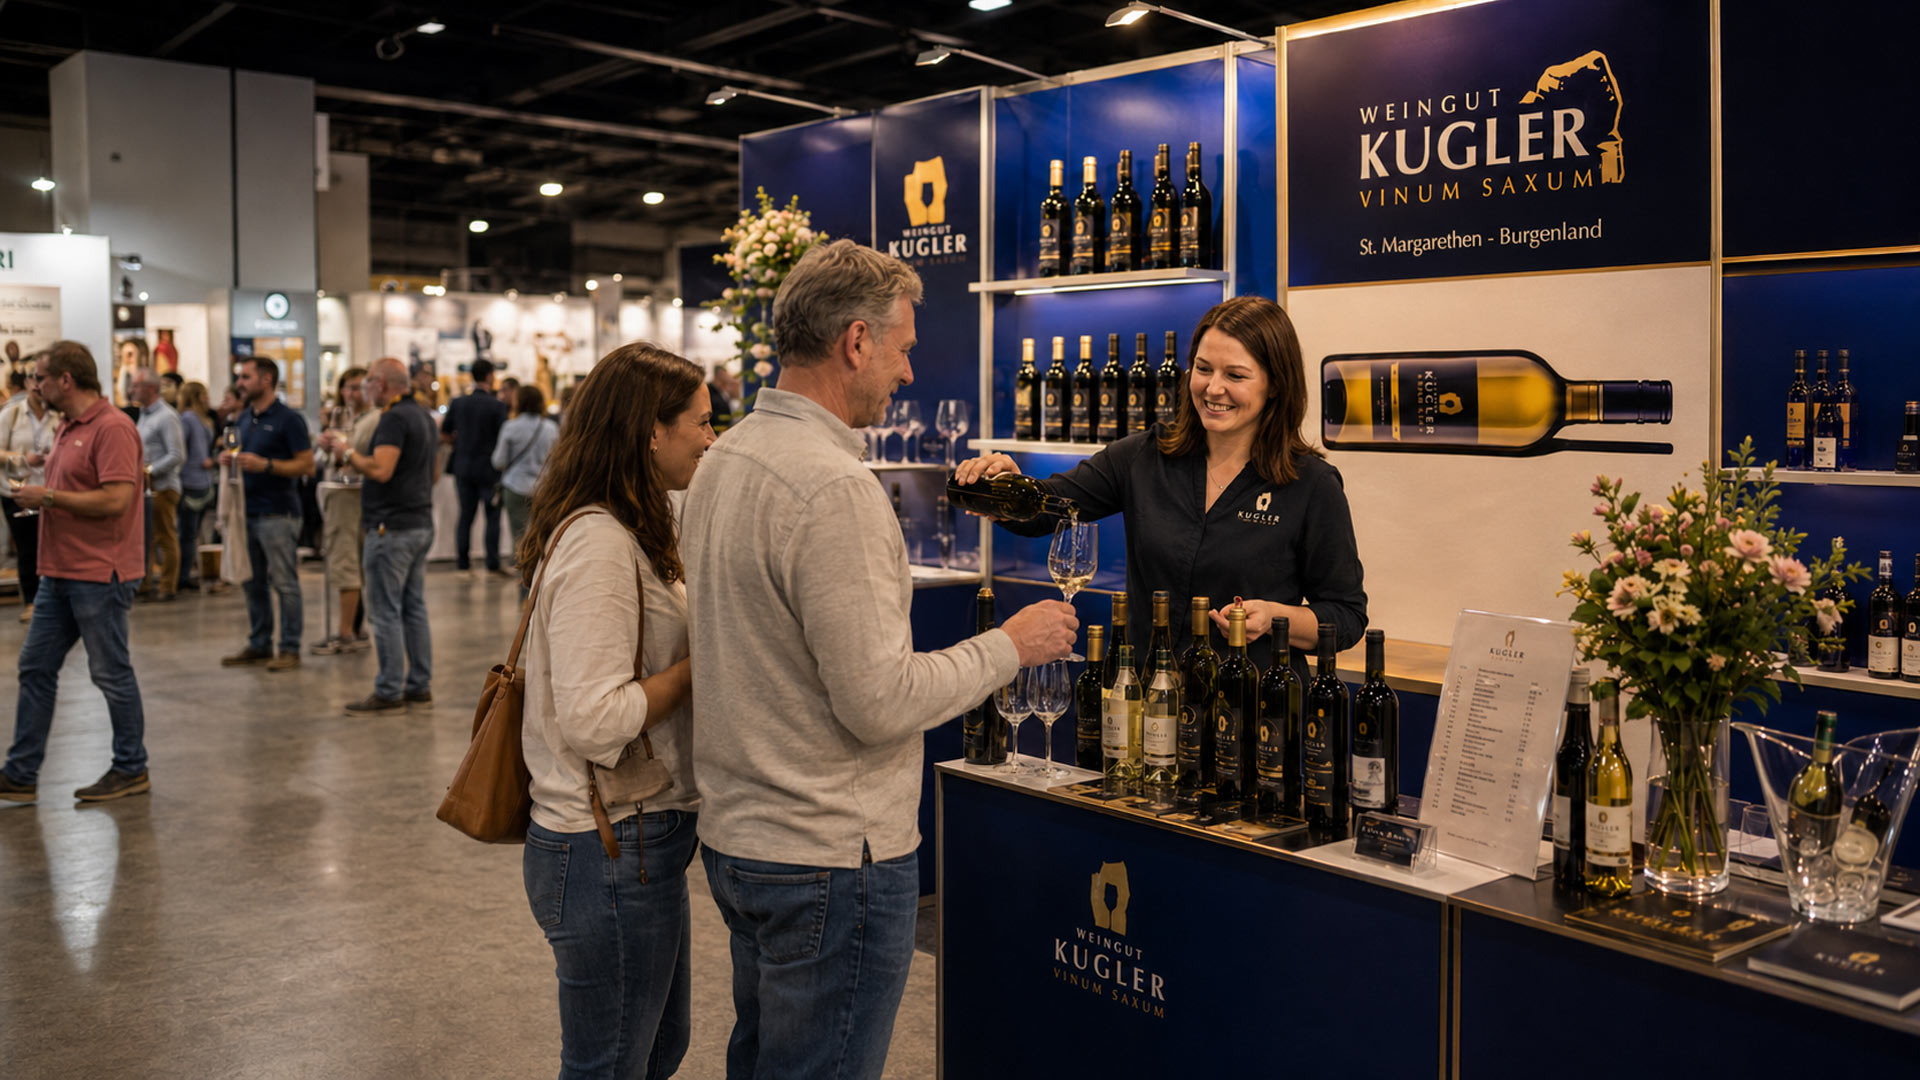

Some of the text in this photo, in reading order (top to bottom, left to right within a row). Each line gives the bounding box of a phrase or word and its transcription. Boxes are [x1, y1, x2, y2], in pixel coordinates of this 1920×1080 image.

[1360, 88, 1501, 125] WEINGUT
[1360, 107, 1590, 180] KUGLER
[1360, 168, 1594, 208] VINUM SAXUM
[888, 233, 967, 258] KUGLER
[902, 224, 951, 238] WEINGUT
[1360, 238, 1377, 255] St.
[1381, 230, 1483, 257] Margarethen
[1500, 218, 1603, 249] Burgenland
[1237, 510, 1280, 523] KUGLER
[1076, 927, 1143, 960] WEINGUT
[1055, 938, 1166, 1002] KUGLER
[1054, 967, 1164, 1018] VINUM SAXUM
